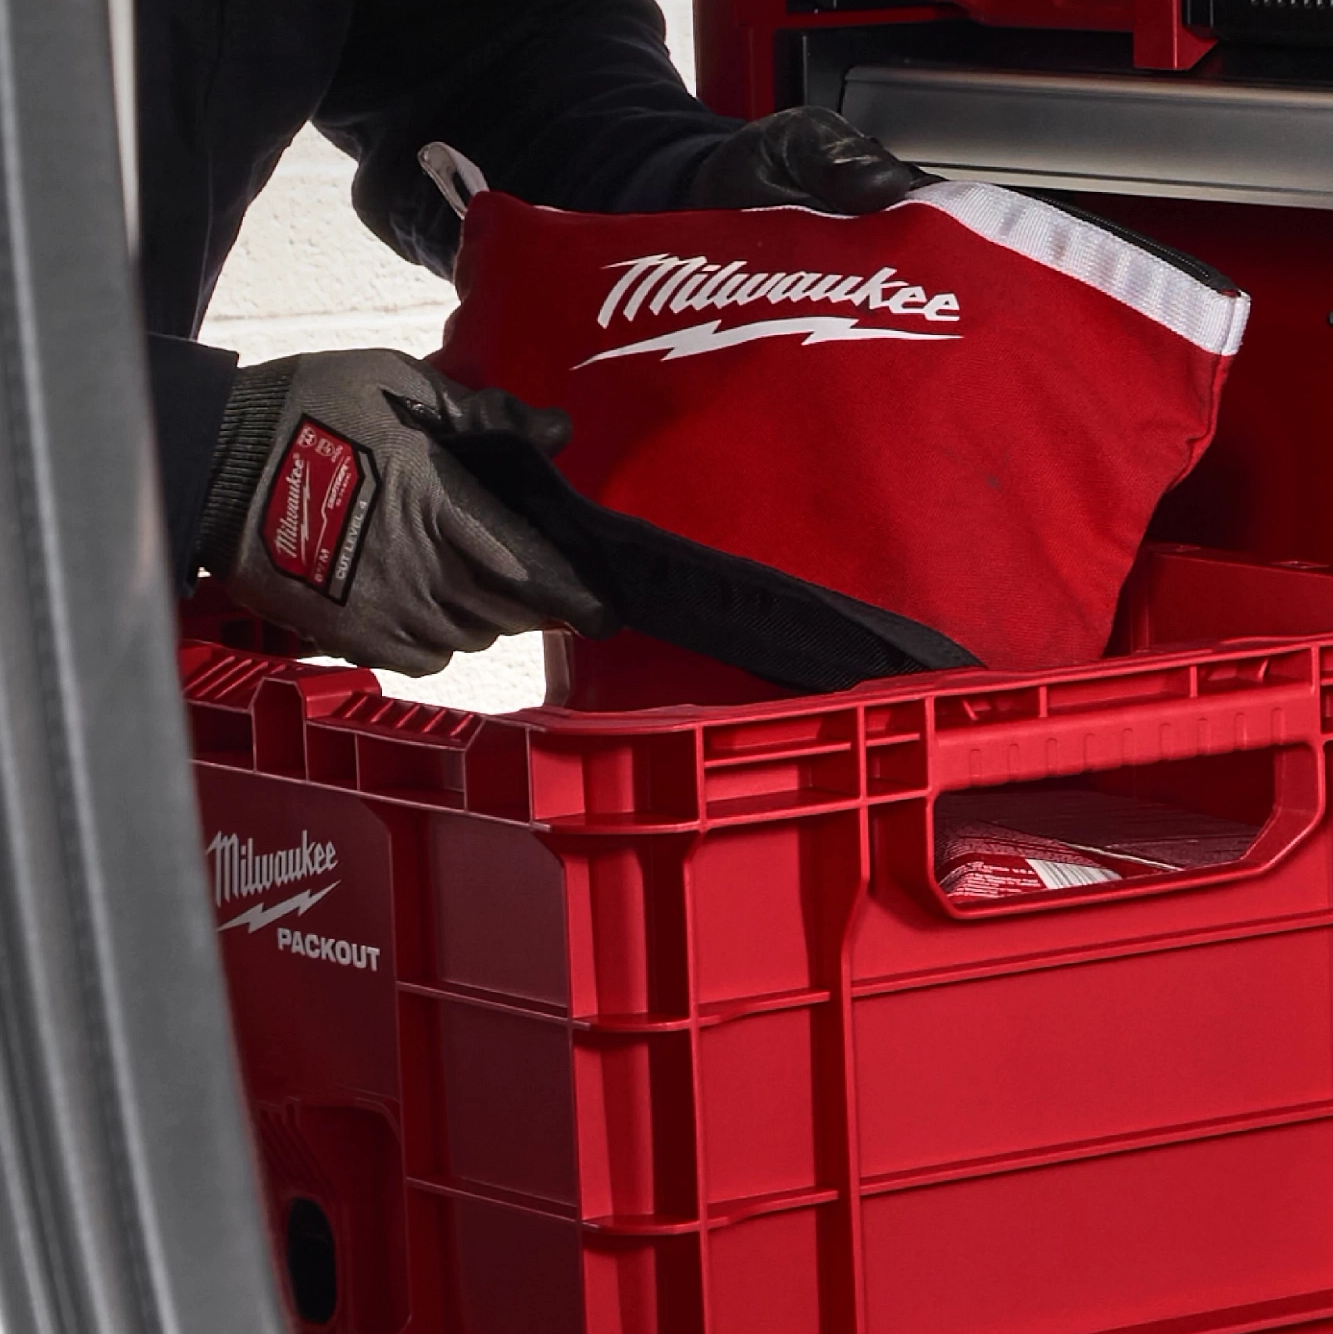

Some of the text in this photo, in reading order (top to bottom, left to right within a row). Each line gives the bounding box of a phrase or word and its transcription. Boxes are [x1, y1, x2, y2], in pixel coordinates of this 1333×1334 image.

[597, 252, 959, 327] Milwaukee
[336, 553, 351, 580] CUT
[344, 514, 365, 553] LEVEL
[206, 829, 339, 908] Milwaukee
[277, 926, 381, 972] PACKOUT
